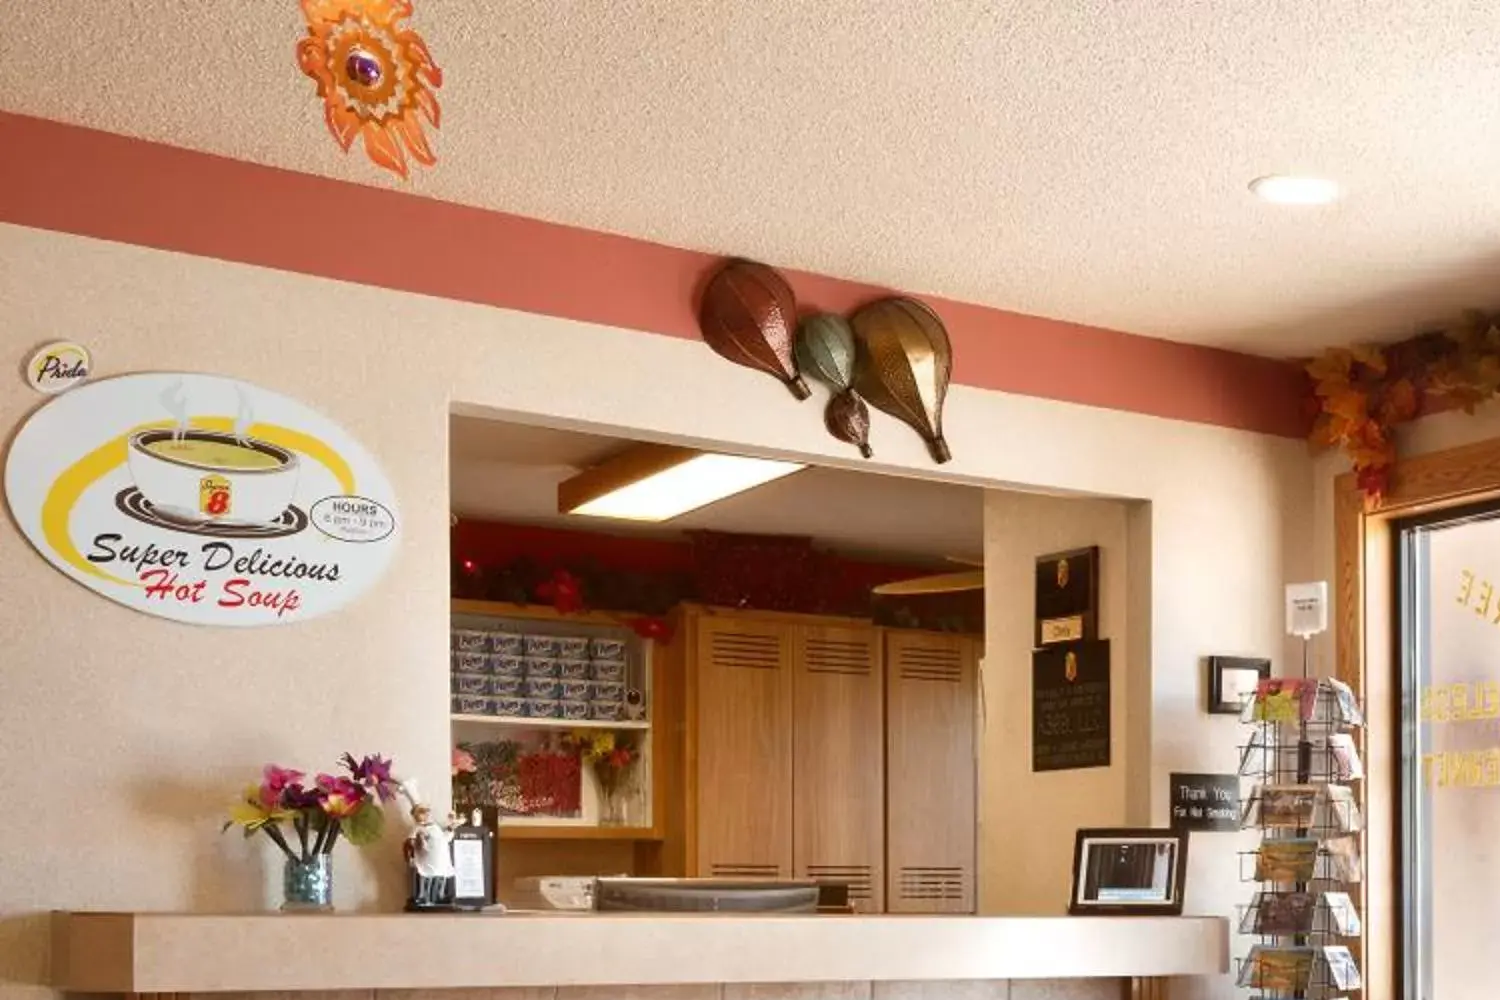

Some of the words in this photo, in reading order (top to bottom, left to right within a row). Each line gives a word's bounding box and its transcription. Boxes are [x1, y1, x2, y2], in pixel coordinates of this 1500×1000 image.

[36, 354, 88, 383] Pride
[332, 501, 378, 517] HOURS
[87, 533, 190, 573] Super
[201, 541, 341, 581] Delicious
[140, 569, 207, 602] Hot
[217, 578, 300, 618] Soup
